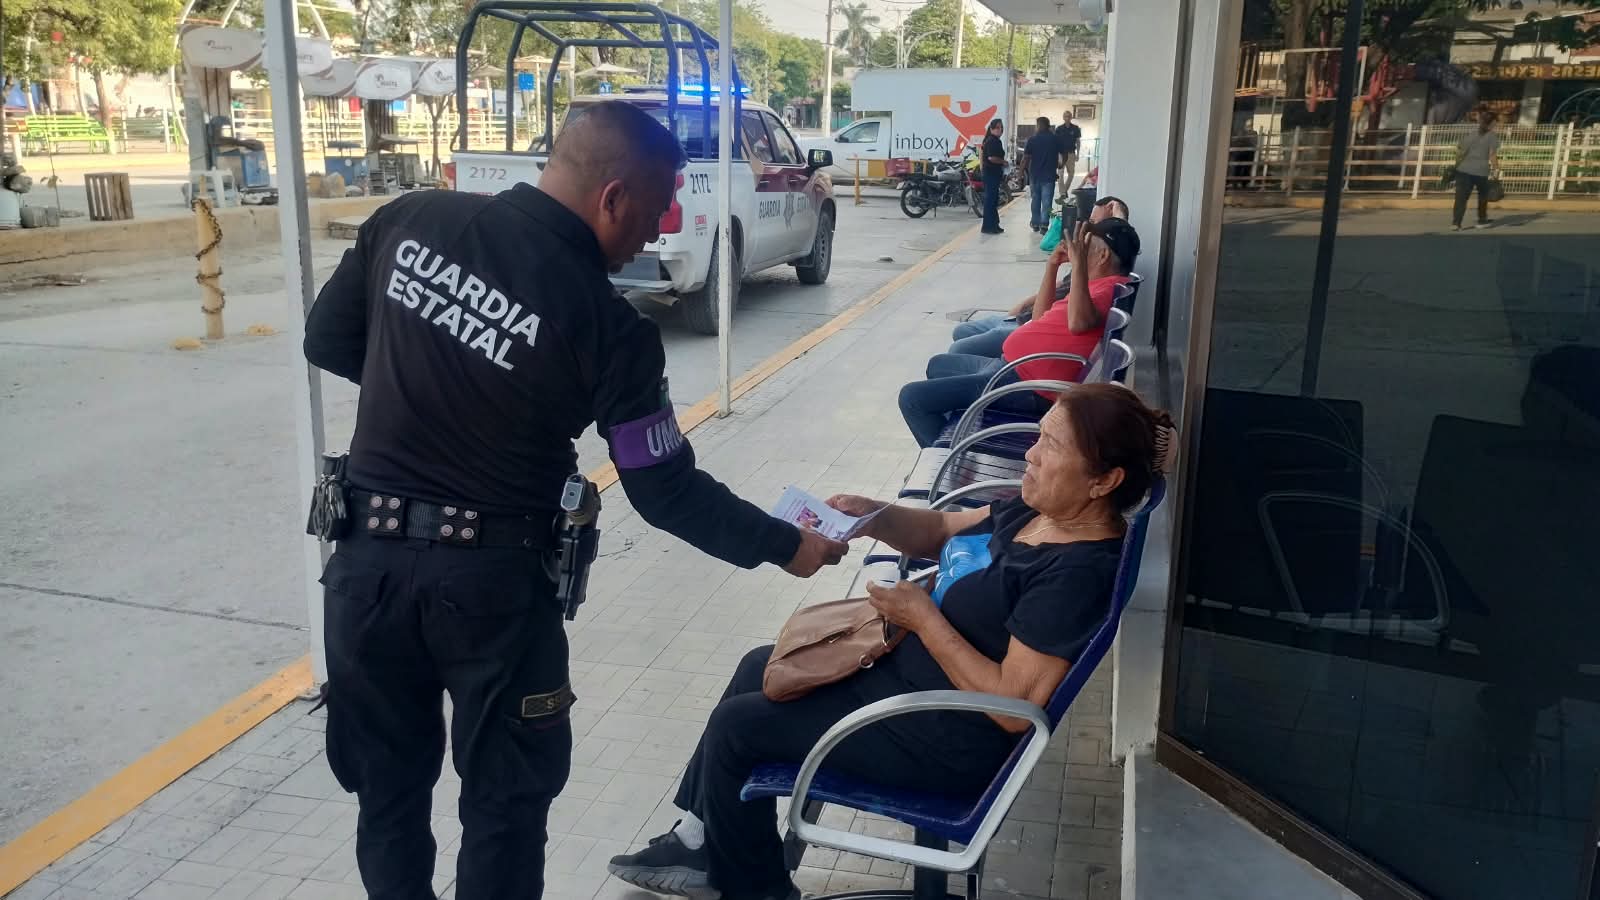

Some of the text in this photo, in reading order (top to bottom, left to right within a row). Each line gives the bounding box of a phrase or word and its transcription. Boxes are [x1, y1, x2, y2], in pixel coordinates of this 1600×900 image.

[895, 132, 944, 150] inbox
[470, 166, 507, 180] 2172
[690, 173, 711, 194] 2172
[396, 239, 541, 347] GUARDIA
[386, 269, 514, 371] ESTATAL
